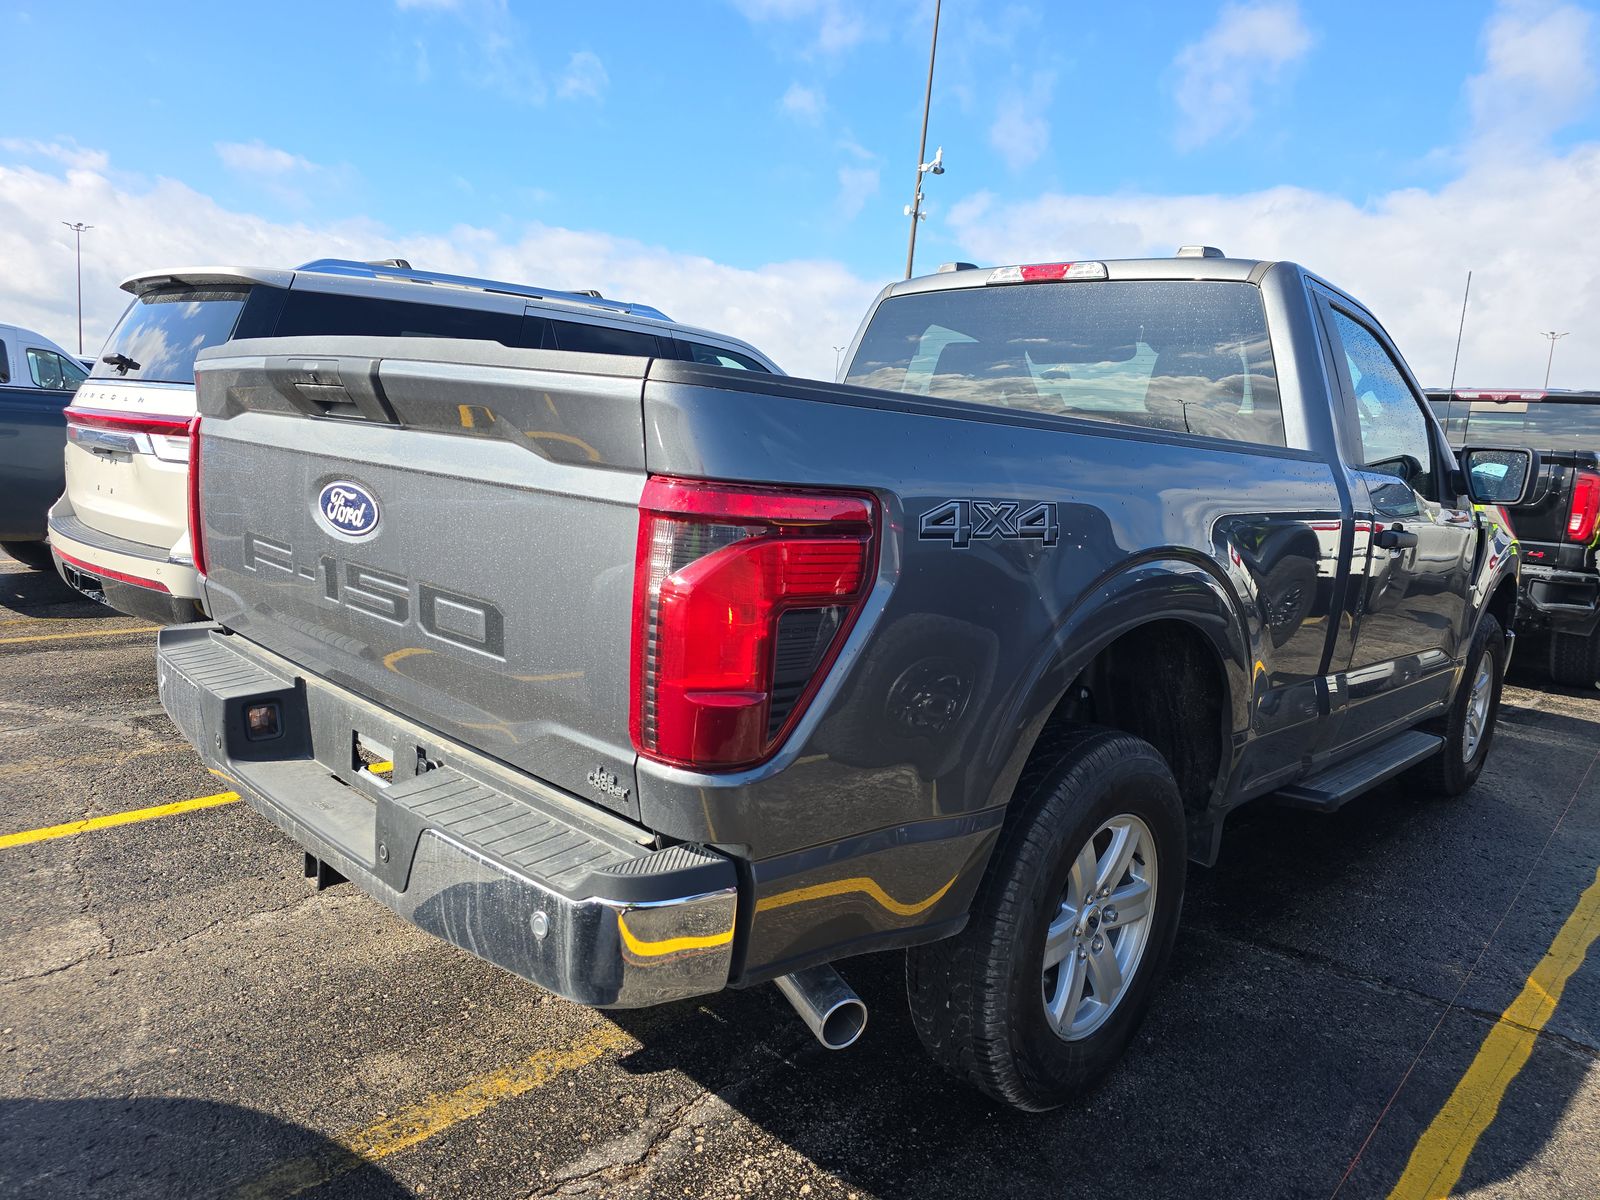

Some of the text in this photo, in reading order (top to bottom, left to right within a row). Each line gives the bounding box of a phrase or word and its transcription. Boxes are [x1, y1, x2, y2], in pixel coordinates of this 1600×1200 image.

[78, 392, 145, 404] LINCOLN
[326, 487, 365, 527] Ford
[244, 531, 506, 662] F-150
